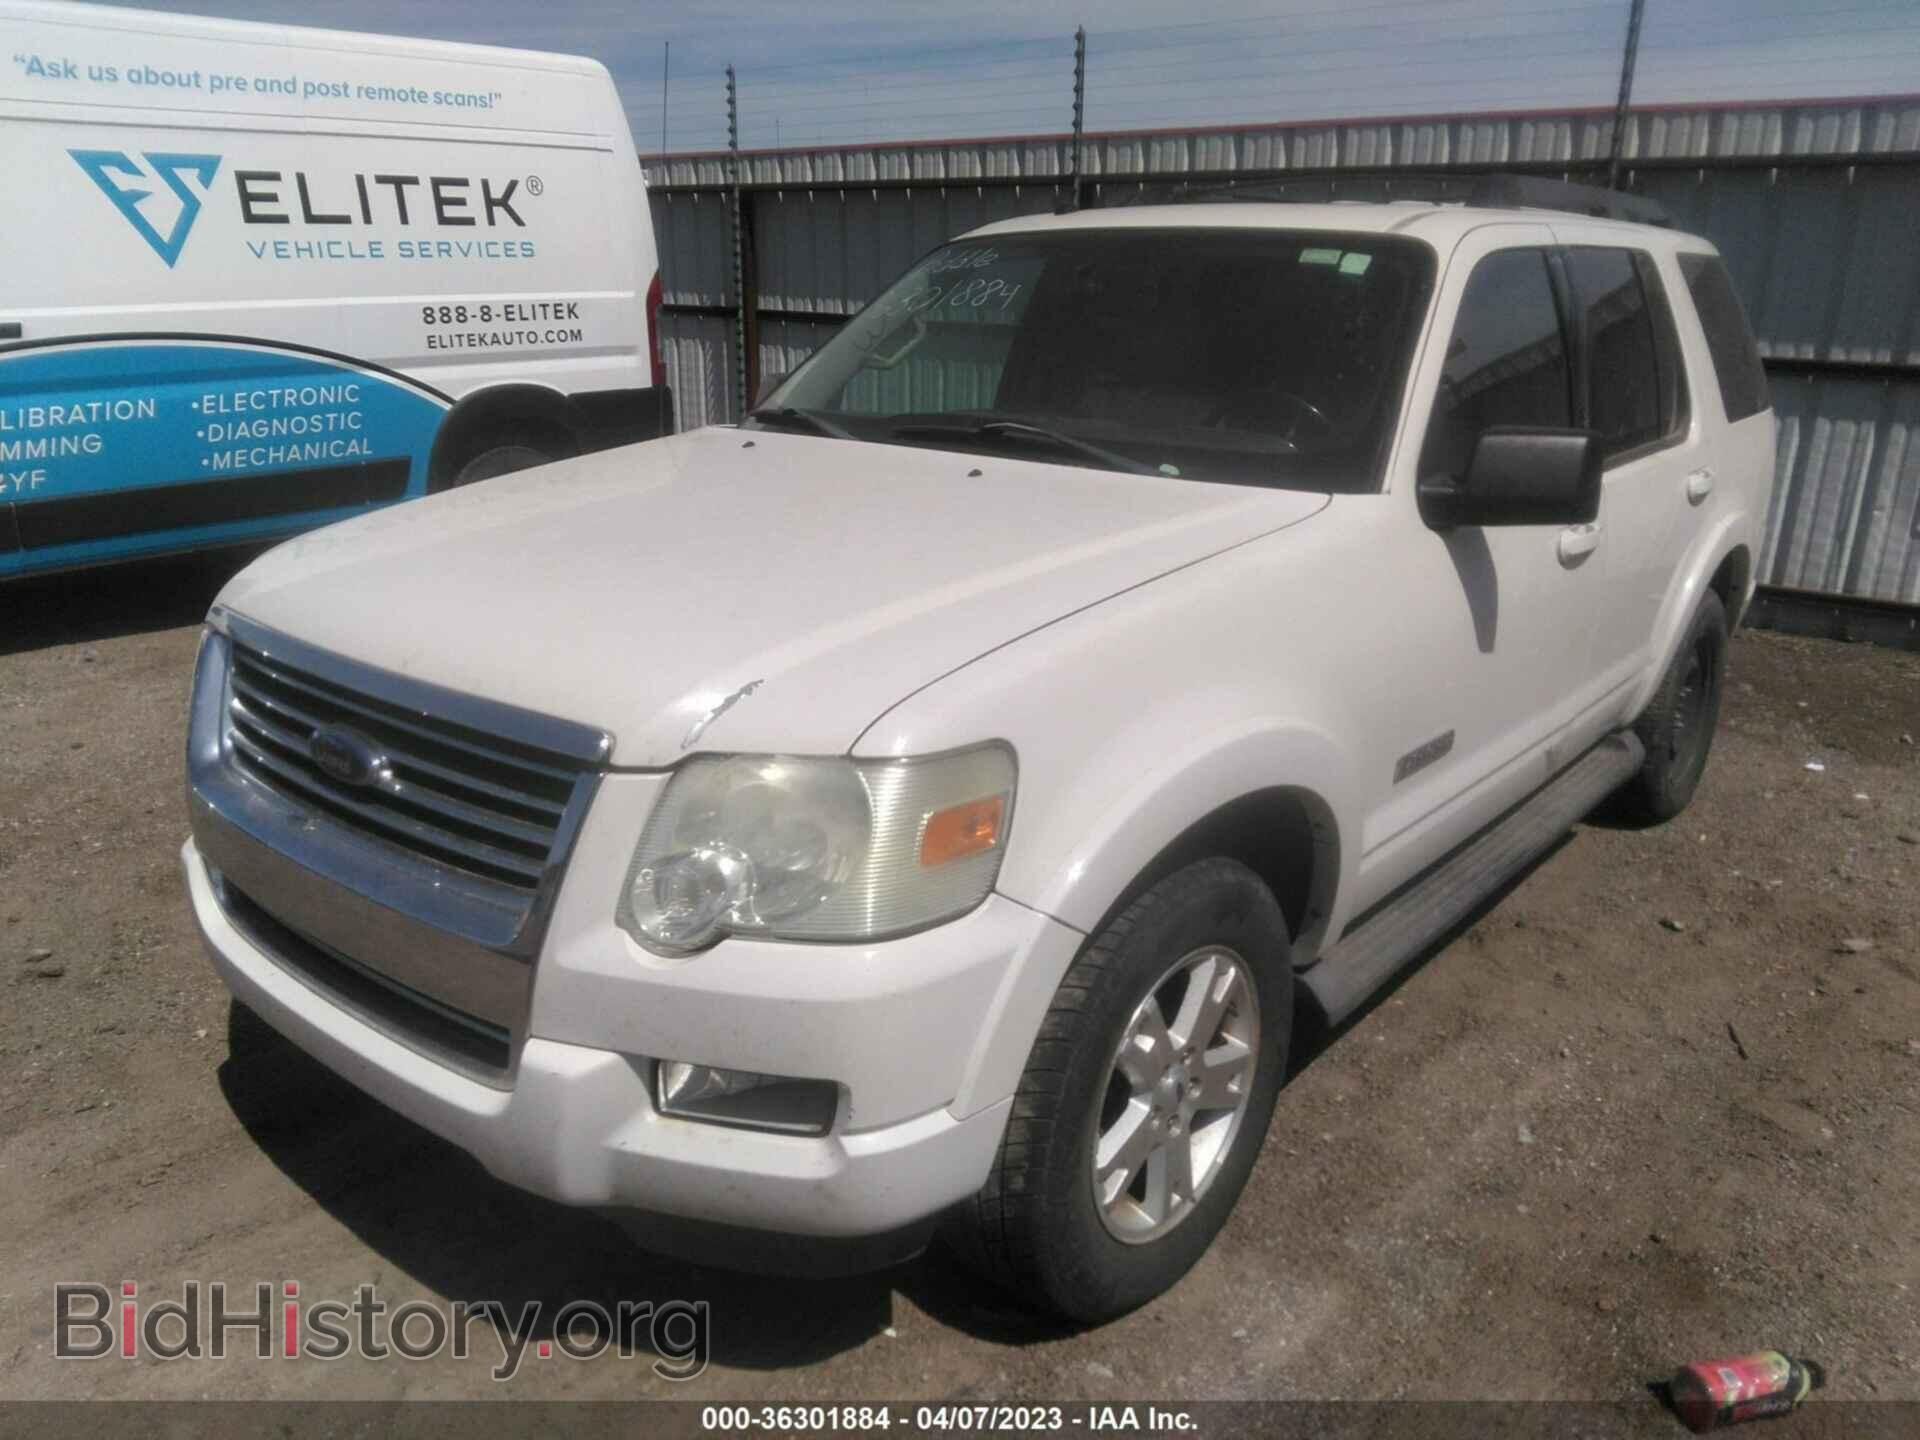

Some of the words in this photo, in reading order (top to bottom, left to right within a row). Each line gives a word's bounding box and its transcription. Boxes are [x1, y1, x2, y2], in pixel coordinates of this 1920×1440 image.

[87, 65, 119, 82] us
[127, 65, 202, 89] about
[209, 75, 248, 93] pre
[254, 76, 297, 94] and
[303, 81, 351, 98] post
[357, 86, 428, 104] remote
[247, 240, 384, 259] VEHICLE
[398, 241, 536, 259] SERVICES
[422, 302, 580, 325] 888-8-ELITEK
[427, 328, 584, 350] ELITEKAUTO.COM
[202, 384, 361, 414] ELECTRONIC
[208, 411, 363, 443] DIAGNOSTIC
[213, 437, 373, 471] MECHANICAL
